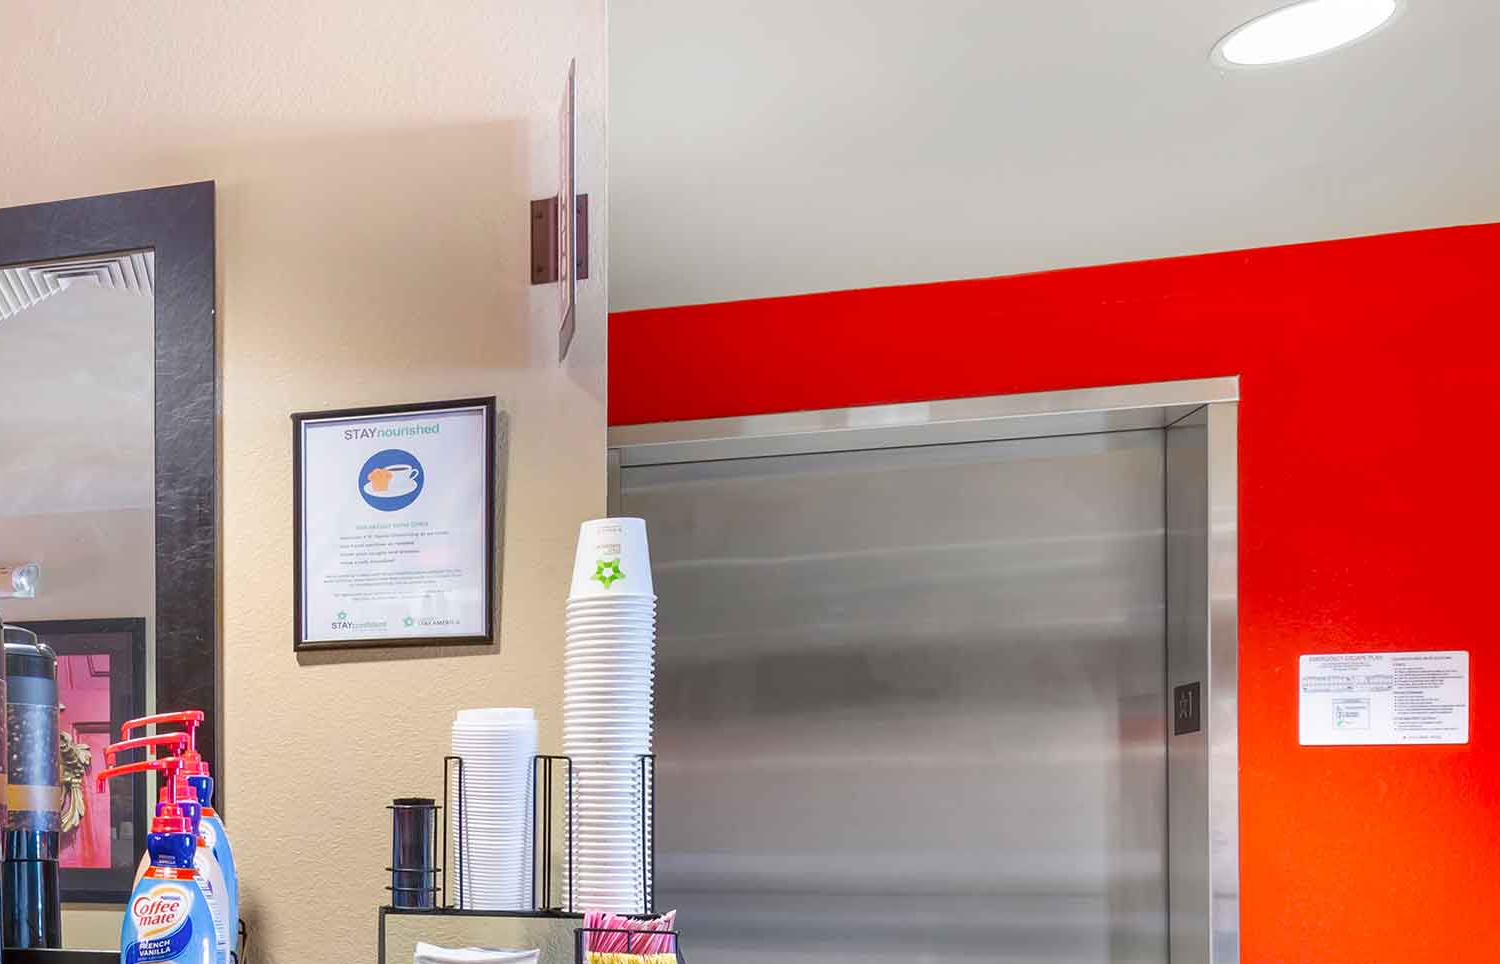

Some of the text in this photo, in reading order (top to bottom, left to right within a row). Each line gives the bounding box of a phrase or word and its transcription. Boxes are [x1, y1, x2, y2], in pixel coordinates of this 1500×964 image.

[133, 896, 180, 918] Coffee
[139, 912, 176, 927] mate
[139, 939, 171, 950] FRENCH
[139, 946, 171, 957] VANILLA
